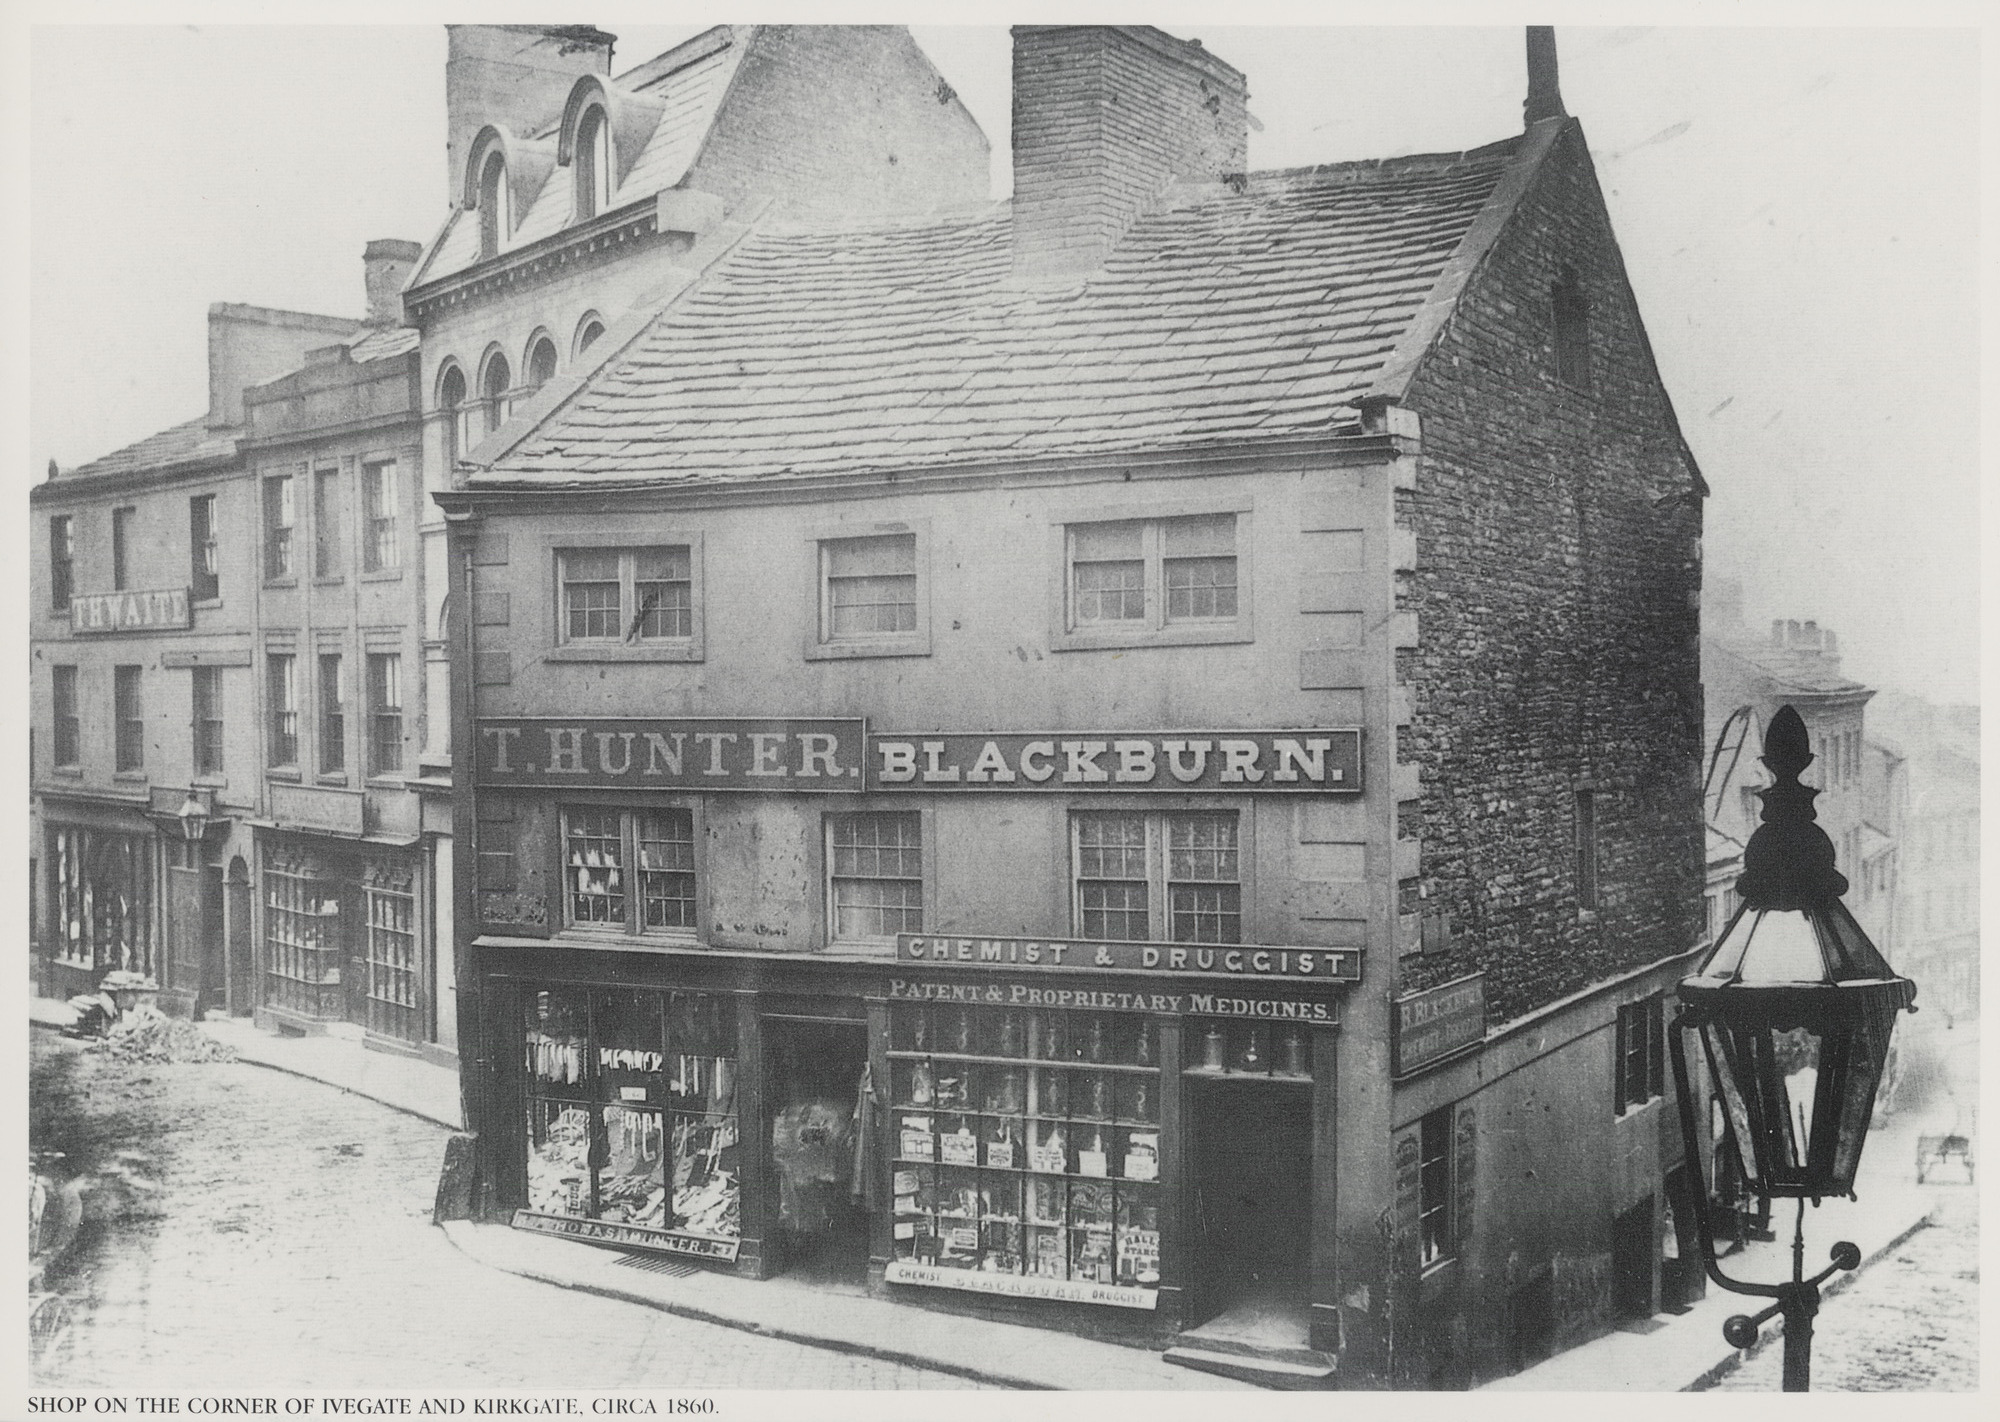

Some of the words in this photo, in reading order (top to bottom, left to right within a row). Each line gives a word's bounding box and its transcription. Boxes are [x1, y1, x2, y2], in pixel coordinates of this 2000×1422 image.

[878, 737, 1344, 784] BLACKBURN.
[908, 939, 1068, 965] CHEMIST
[1095, 948, 1115, 967] &
[1142, 947, 1345, 976] DRUGGIST
[888, 978, 982, 1001] PATENT
[985, 986, 1002, 1001] &
[1009, 983, 1184, 1012] PROPRIETARY
[1188, 992, 1332, 1020] MEDICINES.
